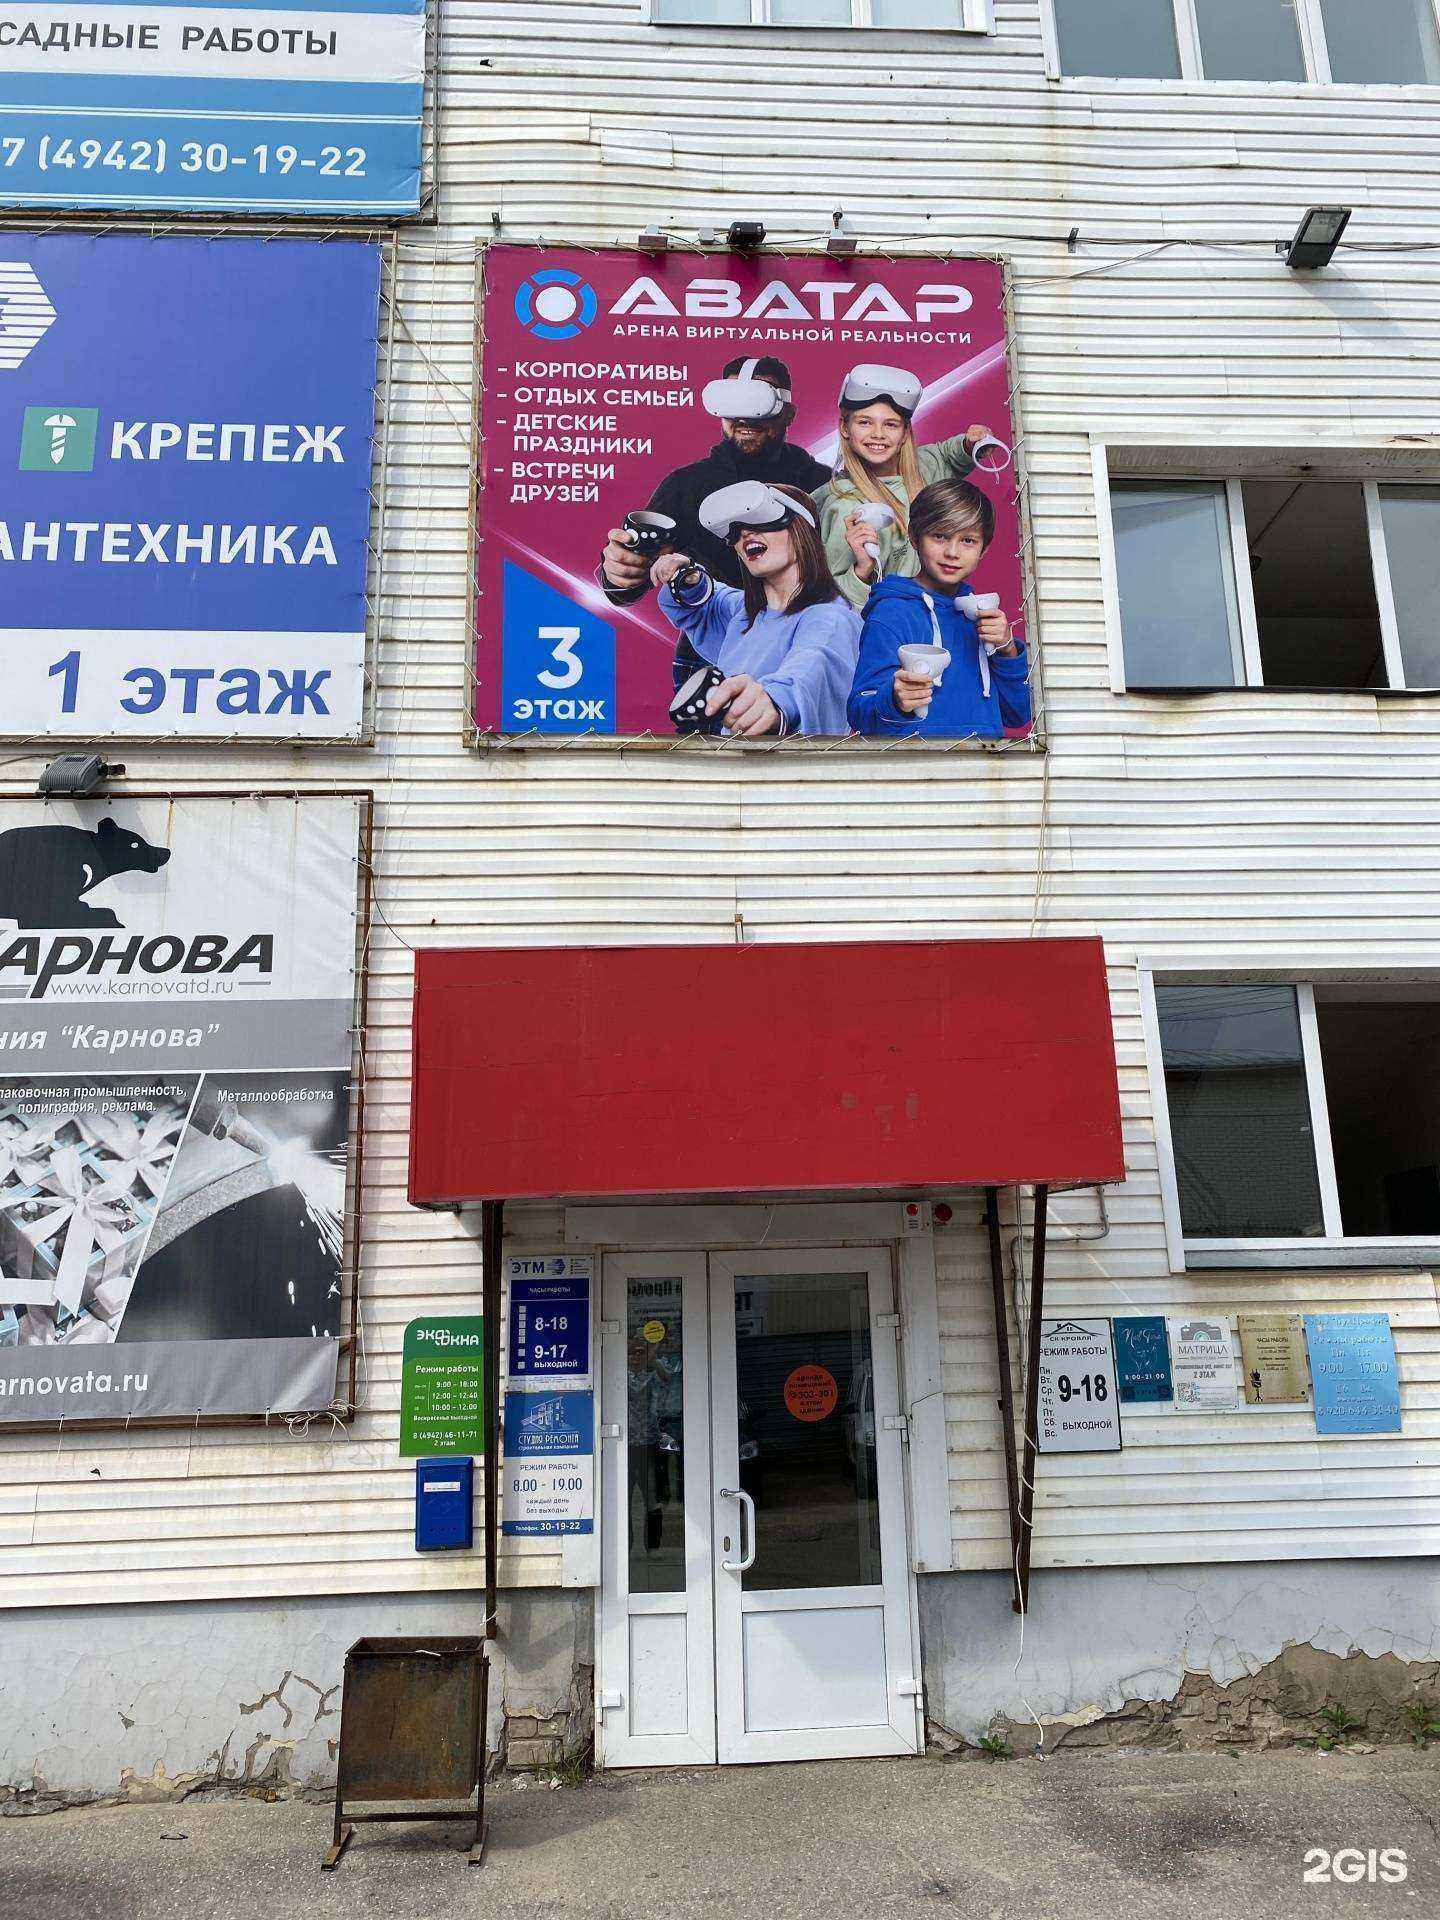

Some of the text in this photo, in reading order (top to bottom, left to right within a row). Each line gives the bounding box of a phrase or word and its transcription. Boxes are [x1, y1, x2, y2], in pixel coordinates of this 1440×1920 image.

[0, 21, 337, 55] САДНЫЕ РАБОТЫ
[38, 134, 166, 173] (4942)
[180, 142, 367, 177] 30-19-22
[608, 276, 974, 323] АВАТАР
[613, 324, 972, 344] АРЕНА ВИРТУАЛЬНОЙ РЕАЛЬНОСТИ
[515, 361, 688, 381] КОРПОРАТИВЫ
[514, 387, 597, 407] ОТДЫХ
[604, 387, 694, 407] СЕМЬЕЙ
[513, 413, 618, 432] ДЕТСКИЕ
[110, 421, 346, 463] КРЕПЕЖ
[513, 435, 652, 455] ПРАЗДНИКИ
[511, 461, 615, 480] ВСТРЕЧИ
[510, 482, 600, 503] ДРУЗЕЙ
[512, 626, 606, 721] 3 этаж
[48, 650, 332, 715] 1 этаж
[0, 932, 274, 999] АРНОВА
[50, 979, 234, 997] www.karnovatd.ru
[73, 1085, 188, 1100] промышленность,
[217, 1088, 335, 1104] Металлообработка
[18, 1101, 158, 1116] полиграфия, реклама.
[511, 1261, 545, 1274] ЭТМ
[534, 1316, 568, 1331] 8-18
[534, 1344, 568, 1359] 9-17
[1040, 1346, 1108, 1356] РЕЖИМ РАБОТЫ
[1178, 1345, 1229, 1355] МАТРИЦА
[415, 1364, 479, 1375] Режим работы
[534, 1360, 578, 1369] выходной
[1040, 1366, 1053, 1375] Пн.
[1040, 1376, 1052, 1384] Вт.
[1199, 1371, 1216, 1379] ЭТАЖ
[1041, 1386, 1054, 1396] Ср.
[1057, 1374, 1108, 1402] 9-18
[431, 1403, 478, 1411] 10:00 12:00
[1042, 1397, 1054, 1405] Чт.
[1043, 1408, 1054, 1417] Пт.
[1043, 1418, 1112, 1430] Сб. ВЫХОДНОЙ
[420, 1431, 443, 1440] (4942)
[1044, 1429, 1058, 1438] Вс.
[513, 1477, 583, 1492] 8.00 19.00
[540, 1522, 581, 1531] 30-19-22
